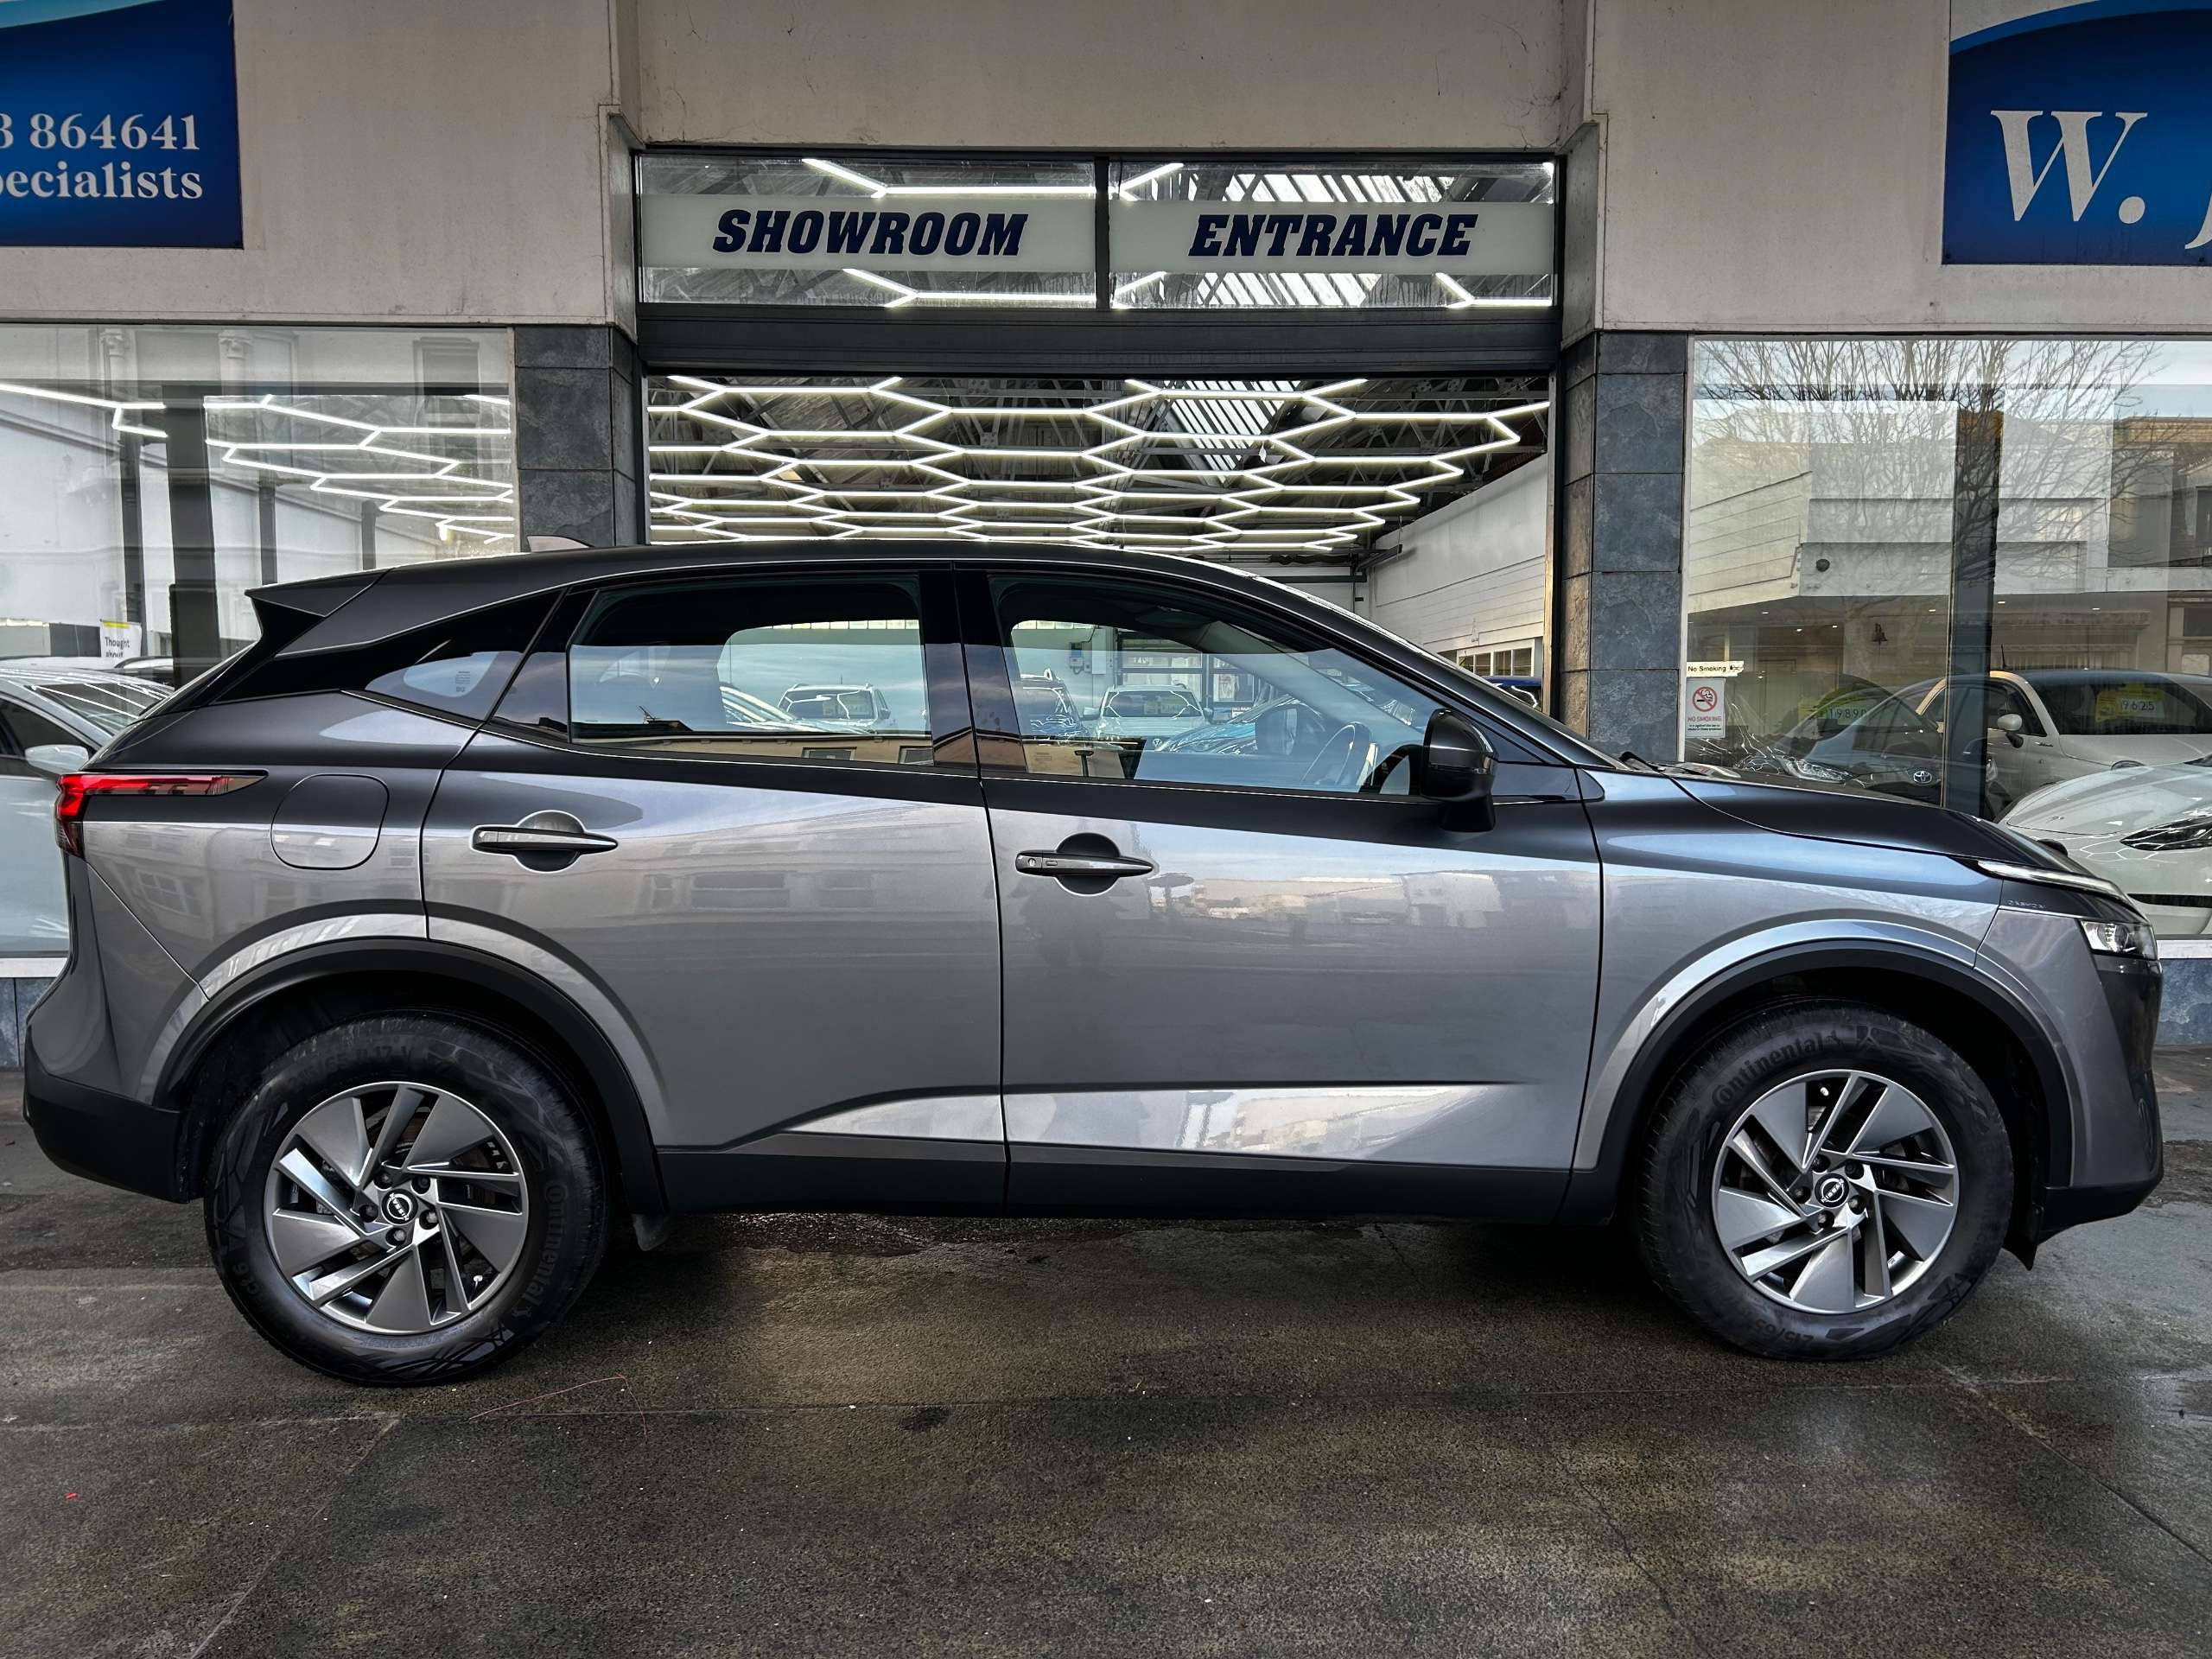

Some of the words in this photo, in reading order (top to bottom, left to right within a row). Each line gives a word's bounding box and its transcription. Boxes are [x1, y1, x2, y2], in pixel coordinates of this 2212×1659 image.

[29, 113, 200, 149] 864641
[0, 161, 203, 200] ecialists
[1991, 110, 2148, 225] W.
[712, 209, 1029, 257] SHOWROOM
[1188, 213, 1479, 257] ENTRANCE
[105, 637, 130, 650] Thought
[1713, 1032, 1824, 1107] Continental
[521, 1181, 569, 1306] Continental
